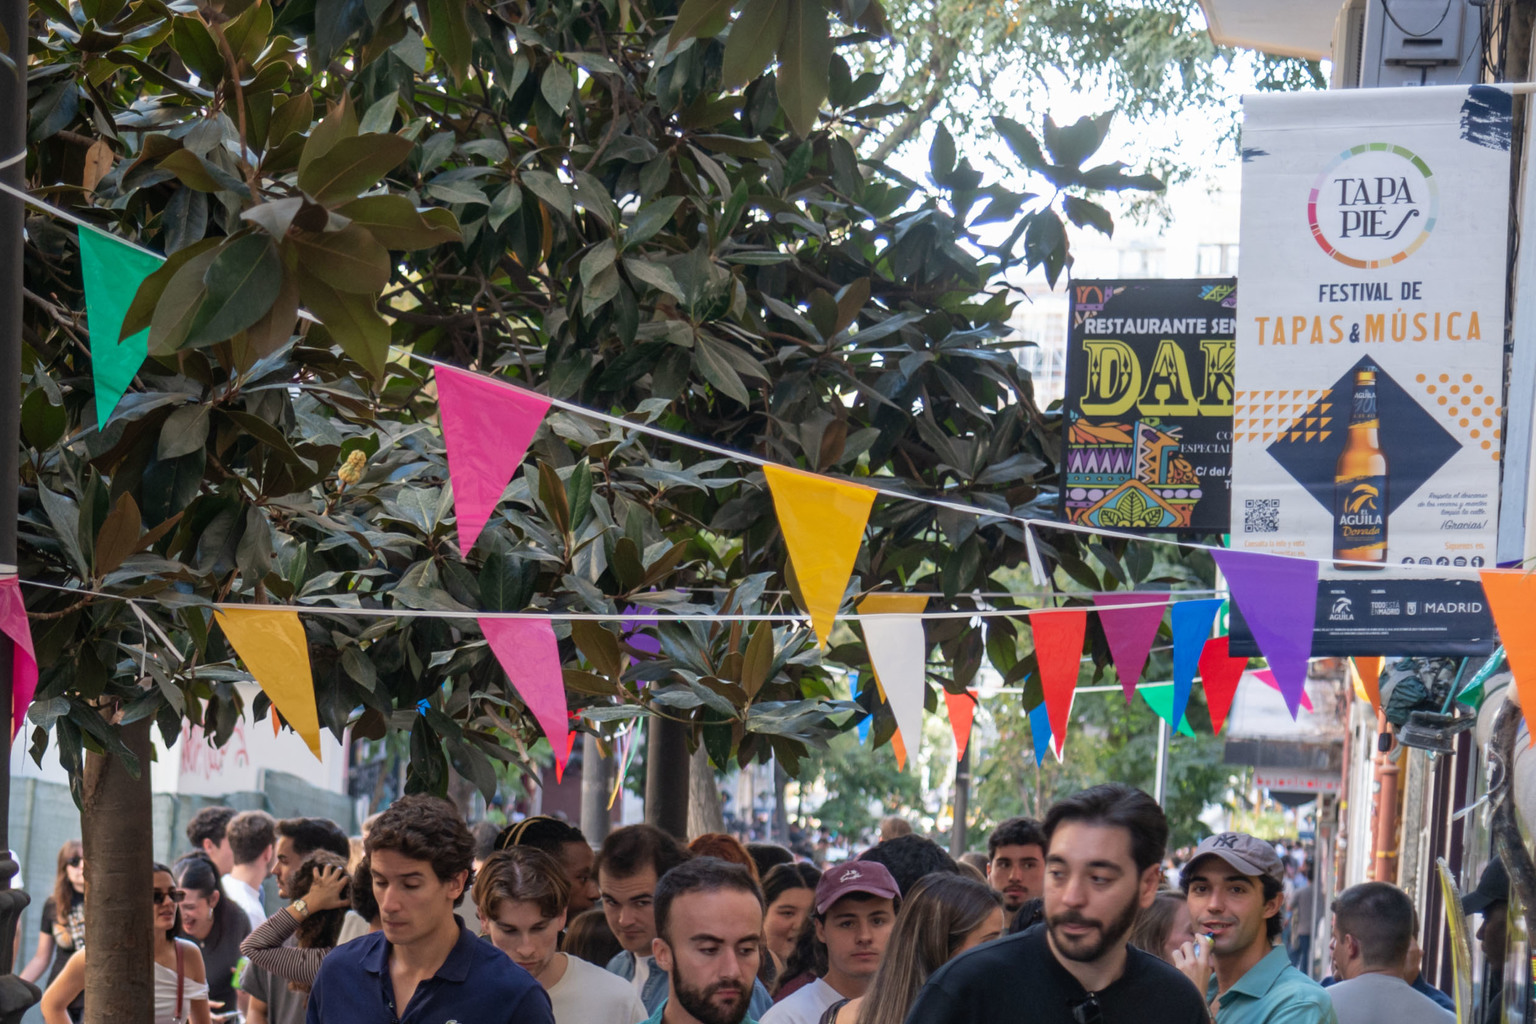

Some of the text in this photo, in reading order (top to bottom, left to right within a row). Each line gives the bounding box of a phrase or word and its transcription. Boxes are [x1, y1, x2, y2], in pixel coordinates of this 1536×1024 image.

[1333, 177, 1416, 206] TAPA
[1339, 206, 1420, 240] PIÉS
[1319, 281, 1422, 302] FESTIVAL DE
[1084, 318, 1207, 335] RESTAURANTE
[1254, 308, 1481, 346] TAPAS & MÚSICA
[1195, 466, 1207, 477] C/
[1209, 466, 1226, 477] del
[1339, 514, 1383, 526] AGUILA
[1440, 519, 1489, 530] ¡Gracias!
[1343, 526, 1381, 537] Dorada
[1425, 602, 1483, 614] MADRID
